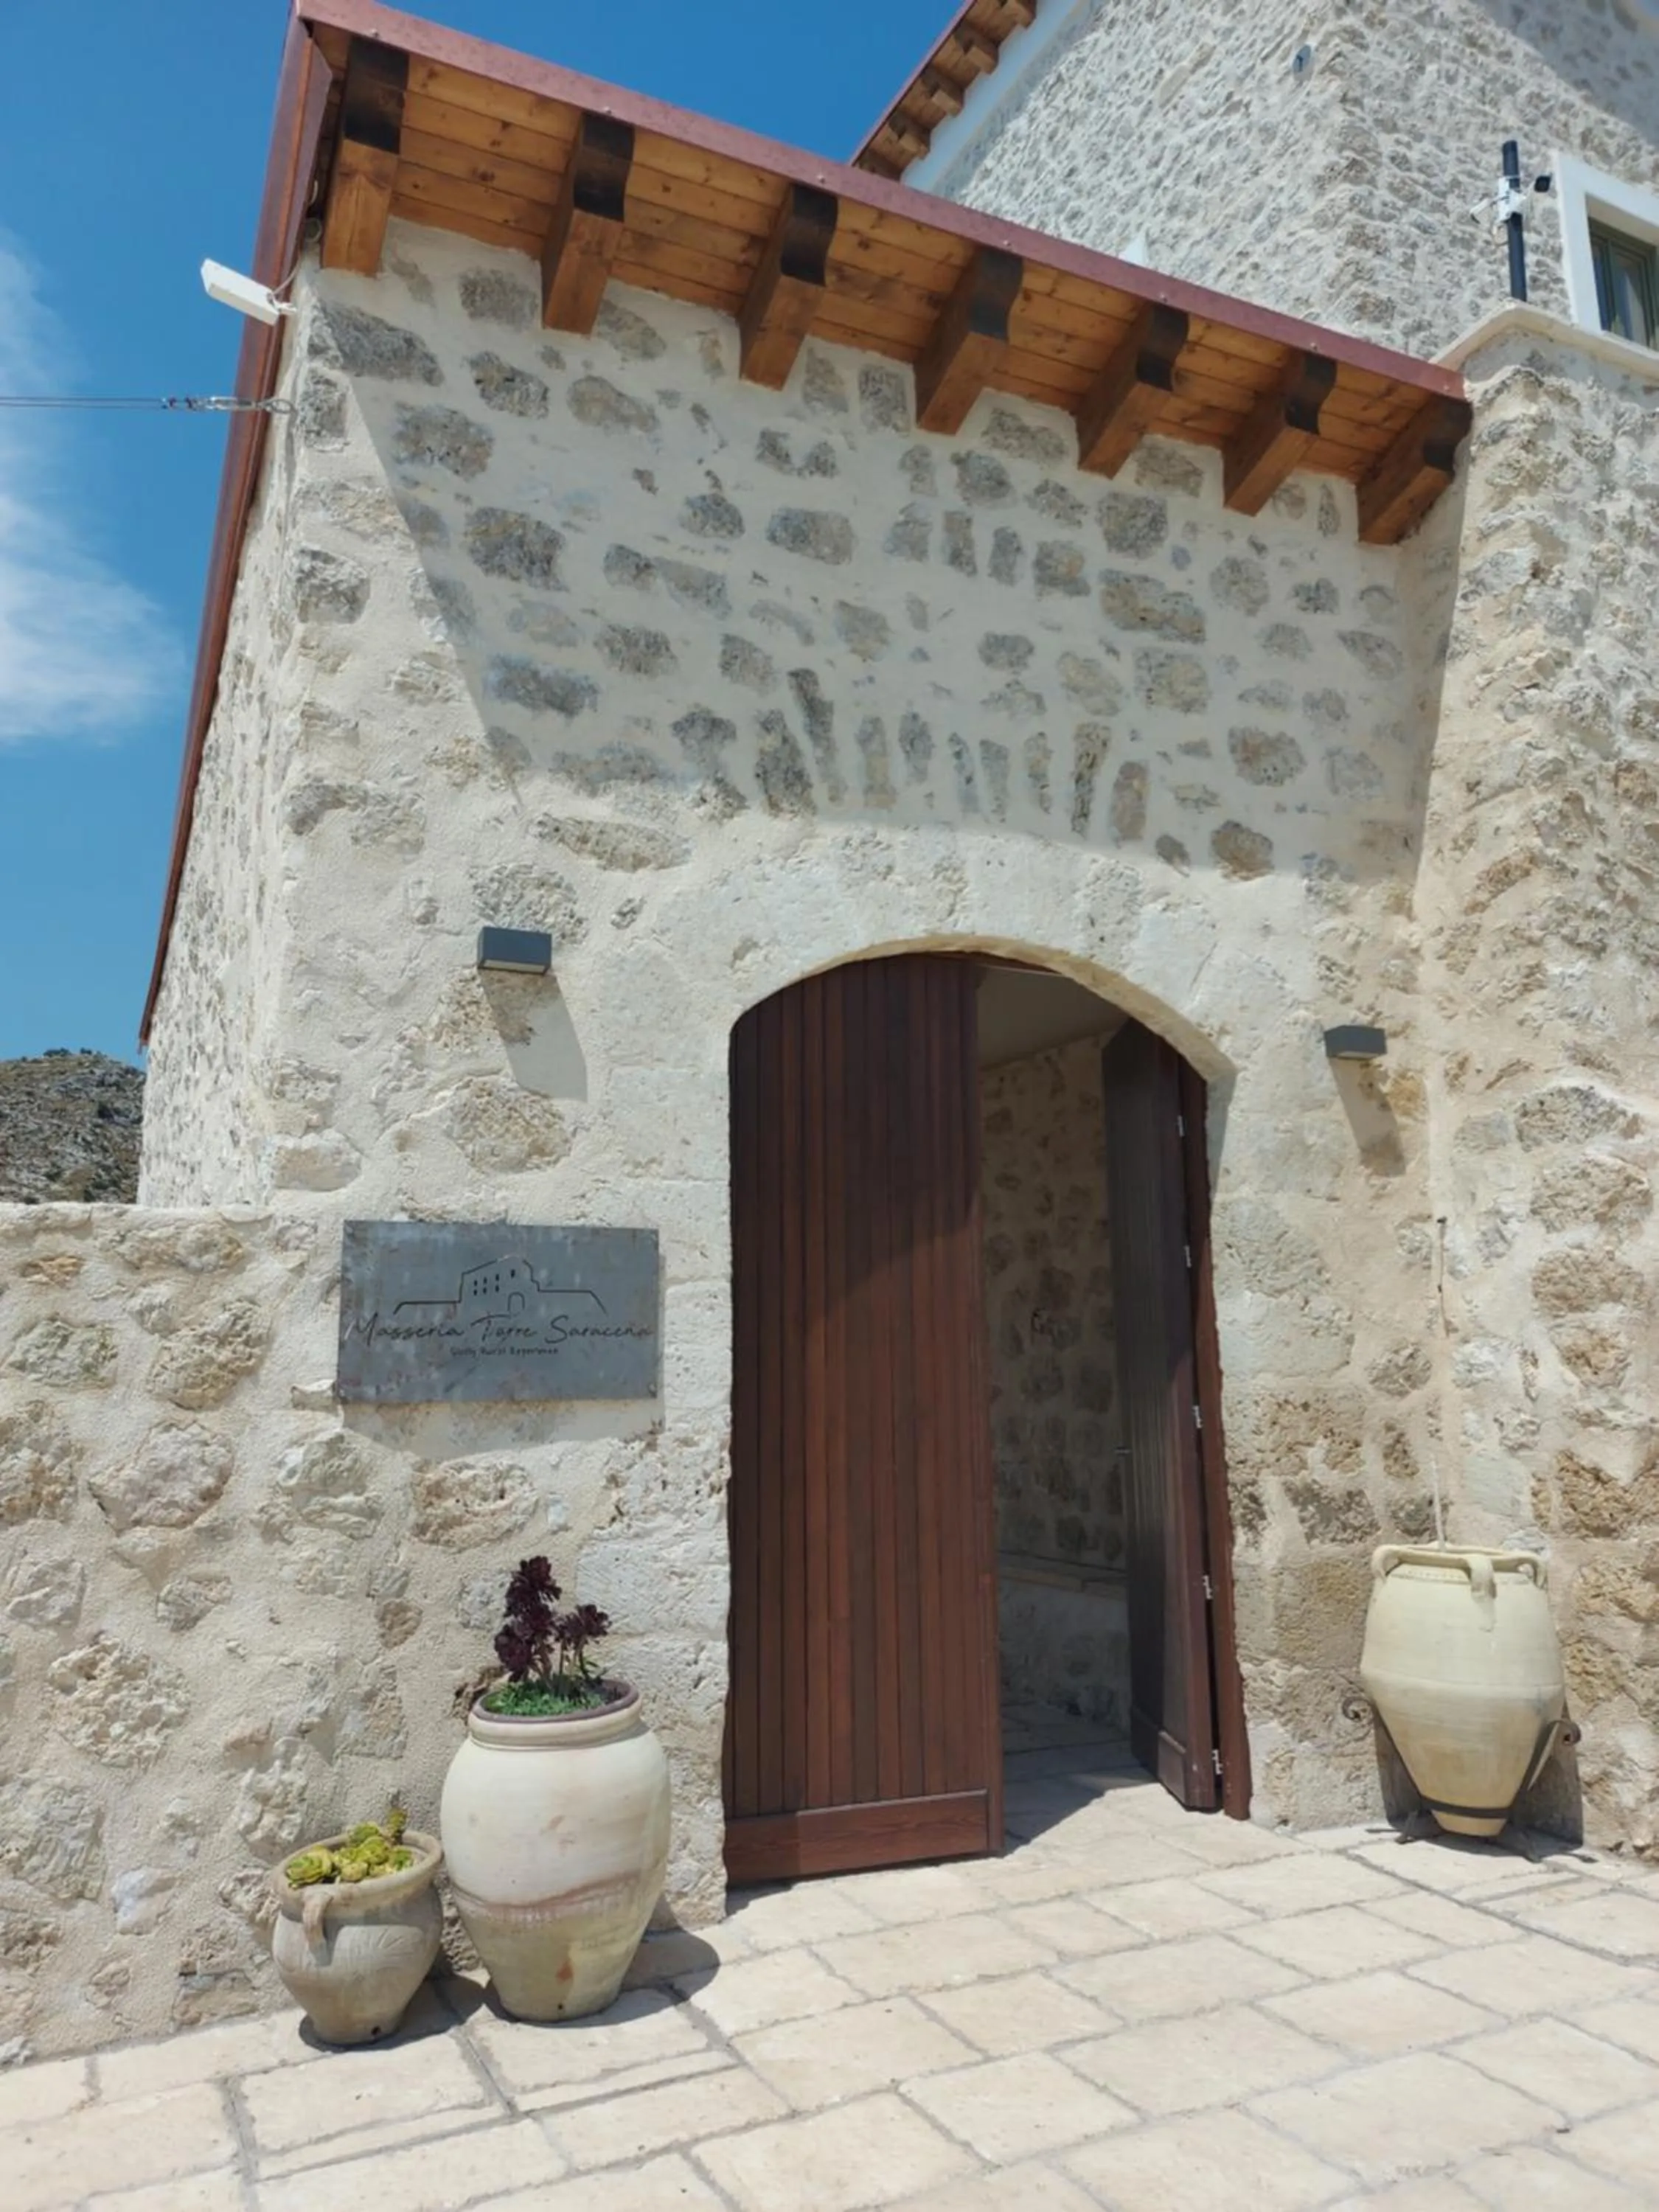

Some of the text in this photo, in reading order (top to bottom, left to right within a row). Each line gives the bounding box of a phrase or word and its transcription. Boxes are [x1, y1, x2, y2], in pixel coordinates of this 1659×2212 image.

[344, 1312, 655, 1347] Masseria Torre Saracena
